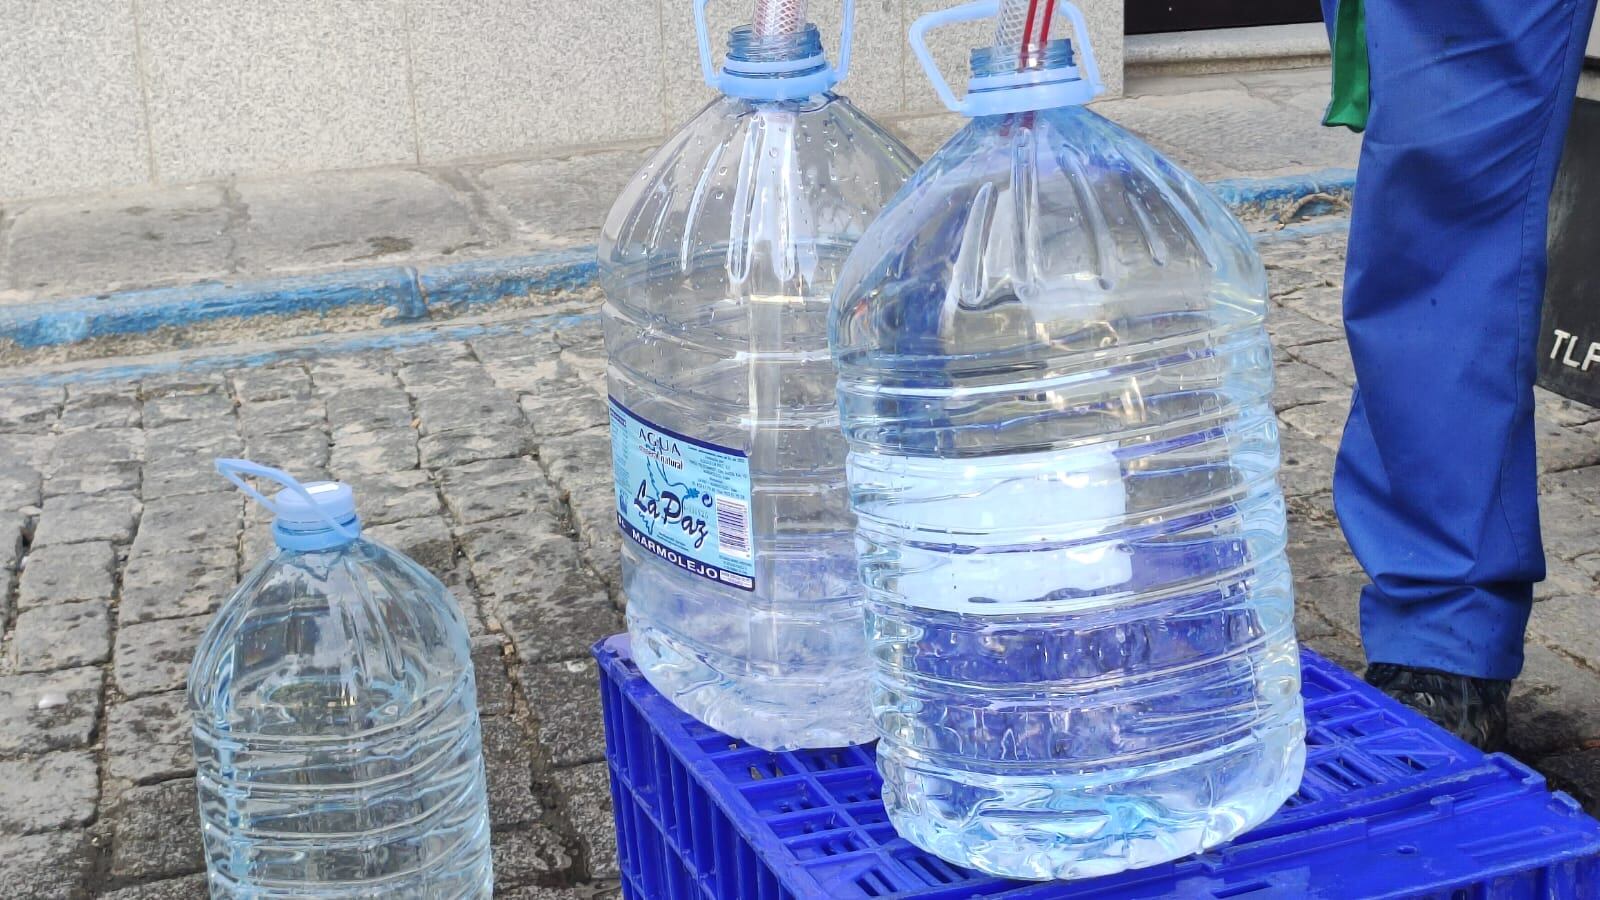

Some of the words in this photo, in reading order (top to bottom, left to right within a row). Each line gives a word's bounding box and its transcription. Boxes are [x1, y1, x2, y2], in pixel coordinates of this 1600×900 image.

[638, 428, 681, 456] AGUA
[660, 454, 683, 470] natural
[634, 479, 660, 518] La
[661, 490, 709, 549] Paz
[632, 529, 718, 579] MARMOLEJO
